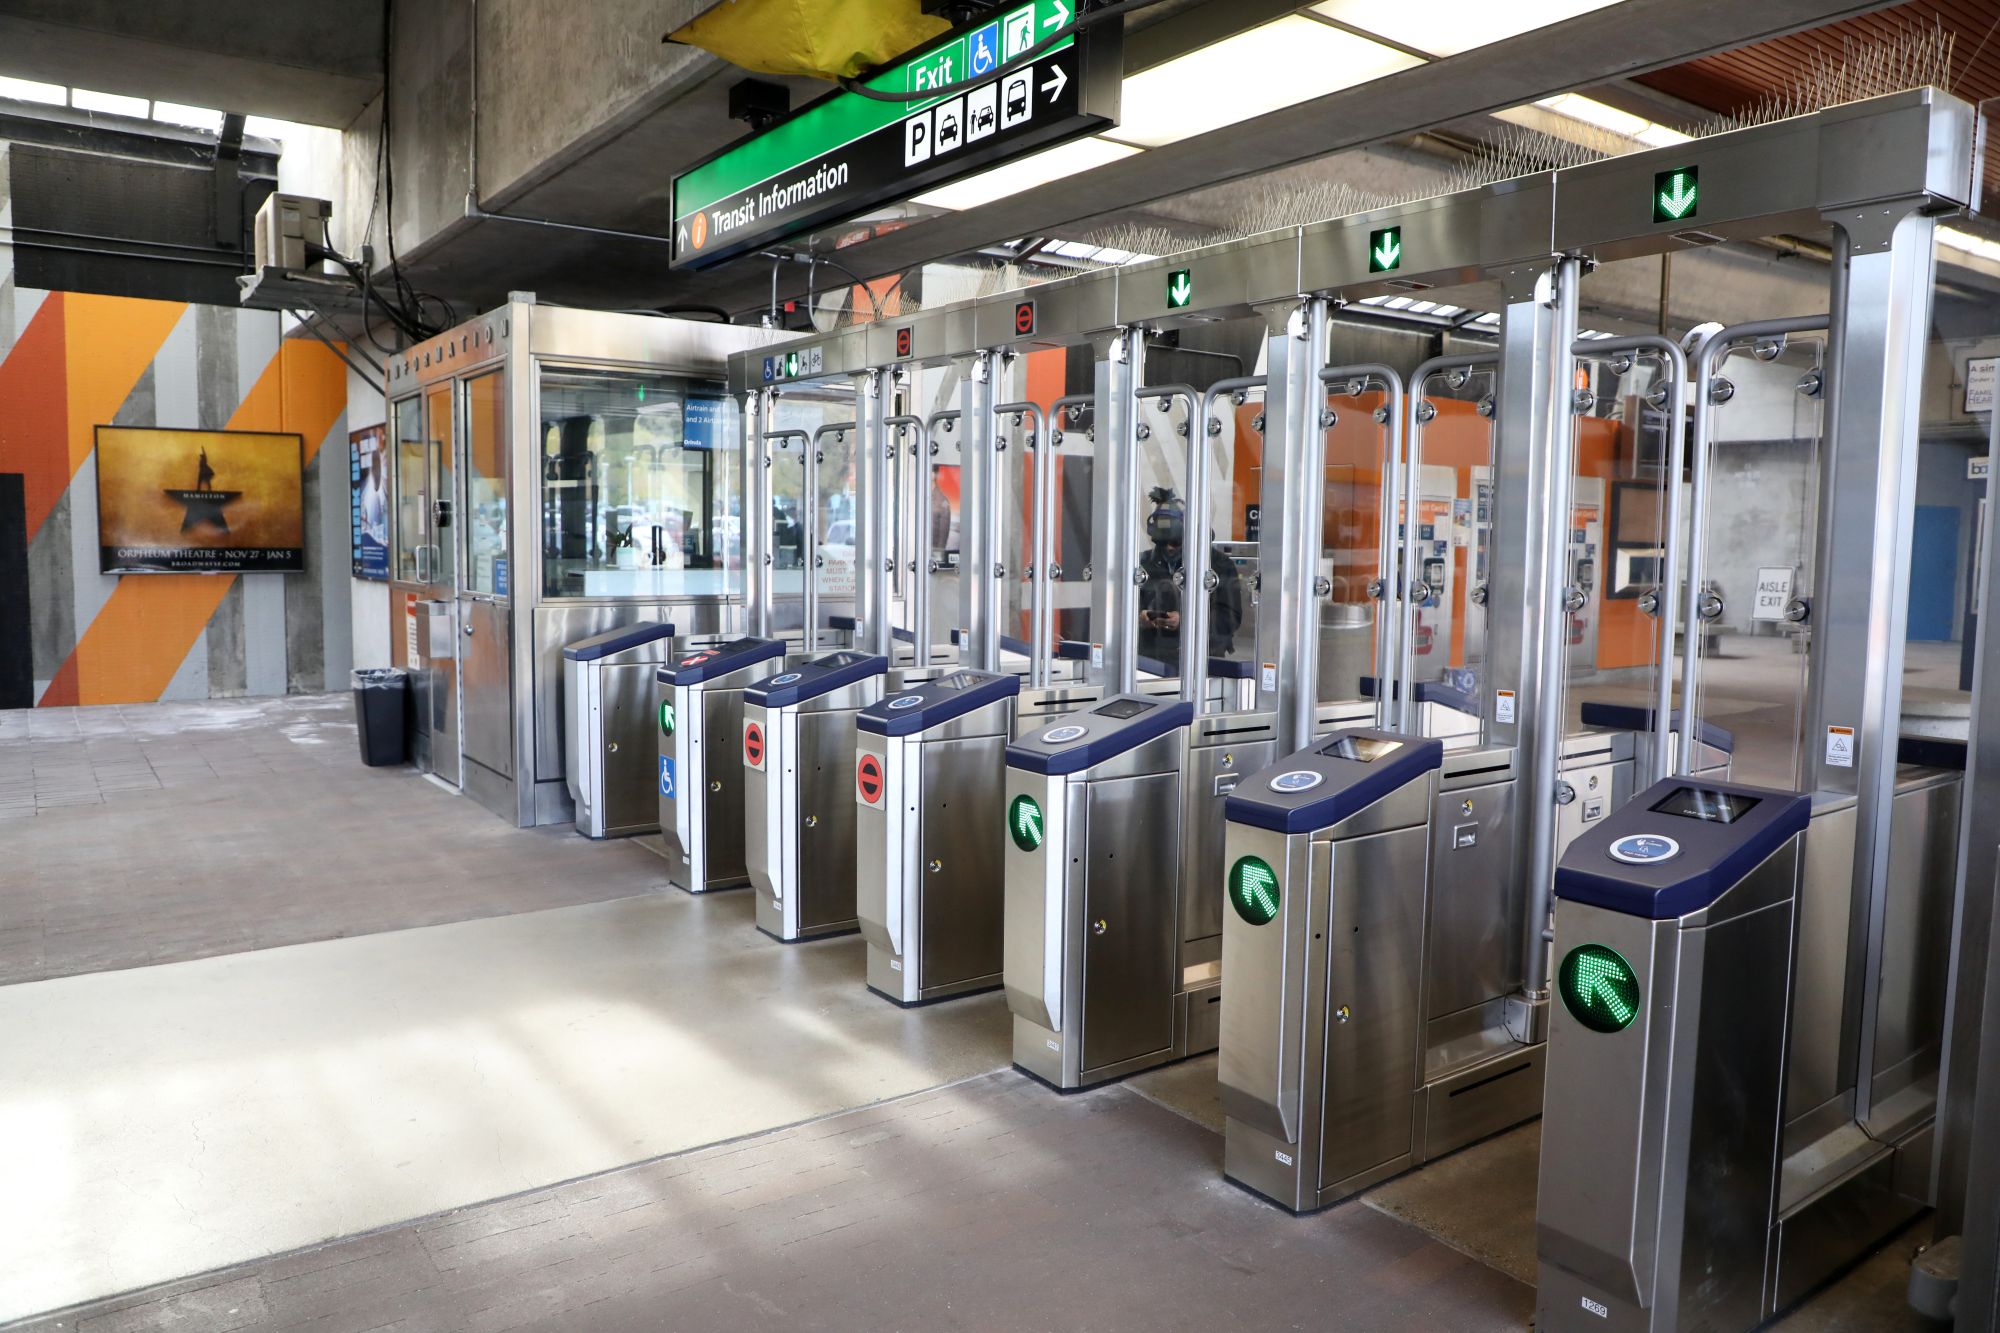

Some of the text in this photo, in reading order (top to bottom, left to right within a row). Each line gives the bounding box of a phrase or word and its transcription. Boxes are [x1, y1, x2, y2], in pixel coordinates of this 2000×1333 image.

[915, 56, 953, 93] Exit
[712, 160, 848, 236] Transit Information
[386, 318, 509, 383] INFORMATION
[117, 549, 171, 559] ORPHEUM
[173, 549, 216, 559] THEATRE
[225, 550, 247, 559] NOV
[249, 550, 260, 559] 27
[266, 550, 284, 559] JAN
[285, 550, 292, 559] 5
[1759, 581, 1788, 592] AISLE
[1760, 596, 1783, 607] EXIT
[1584, 1299, 1606, 1316] 1269
